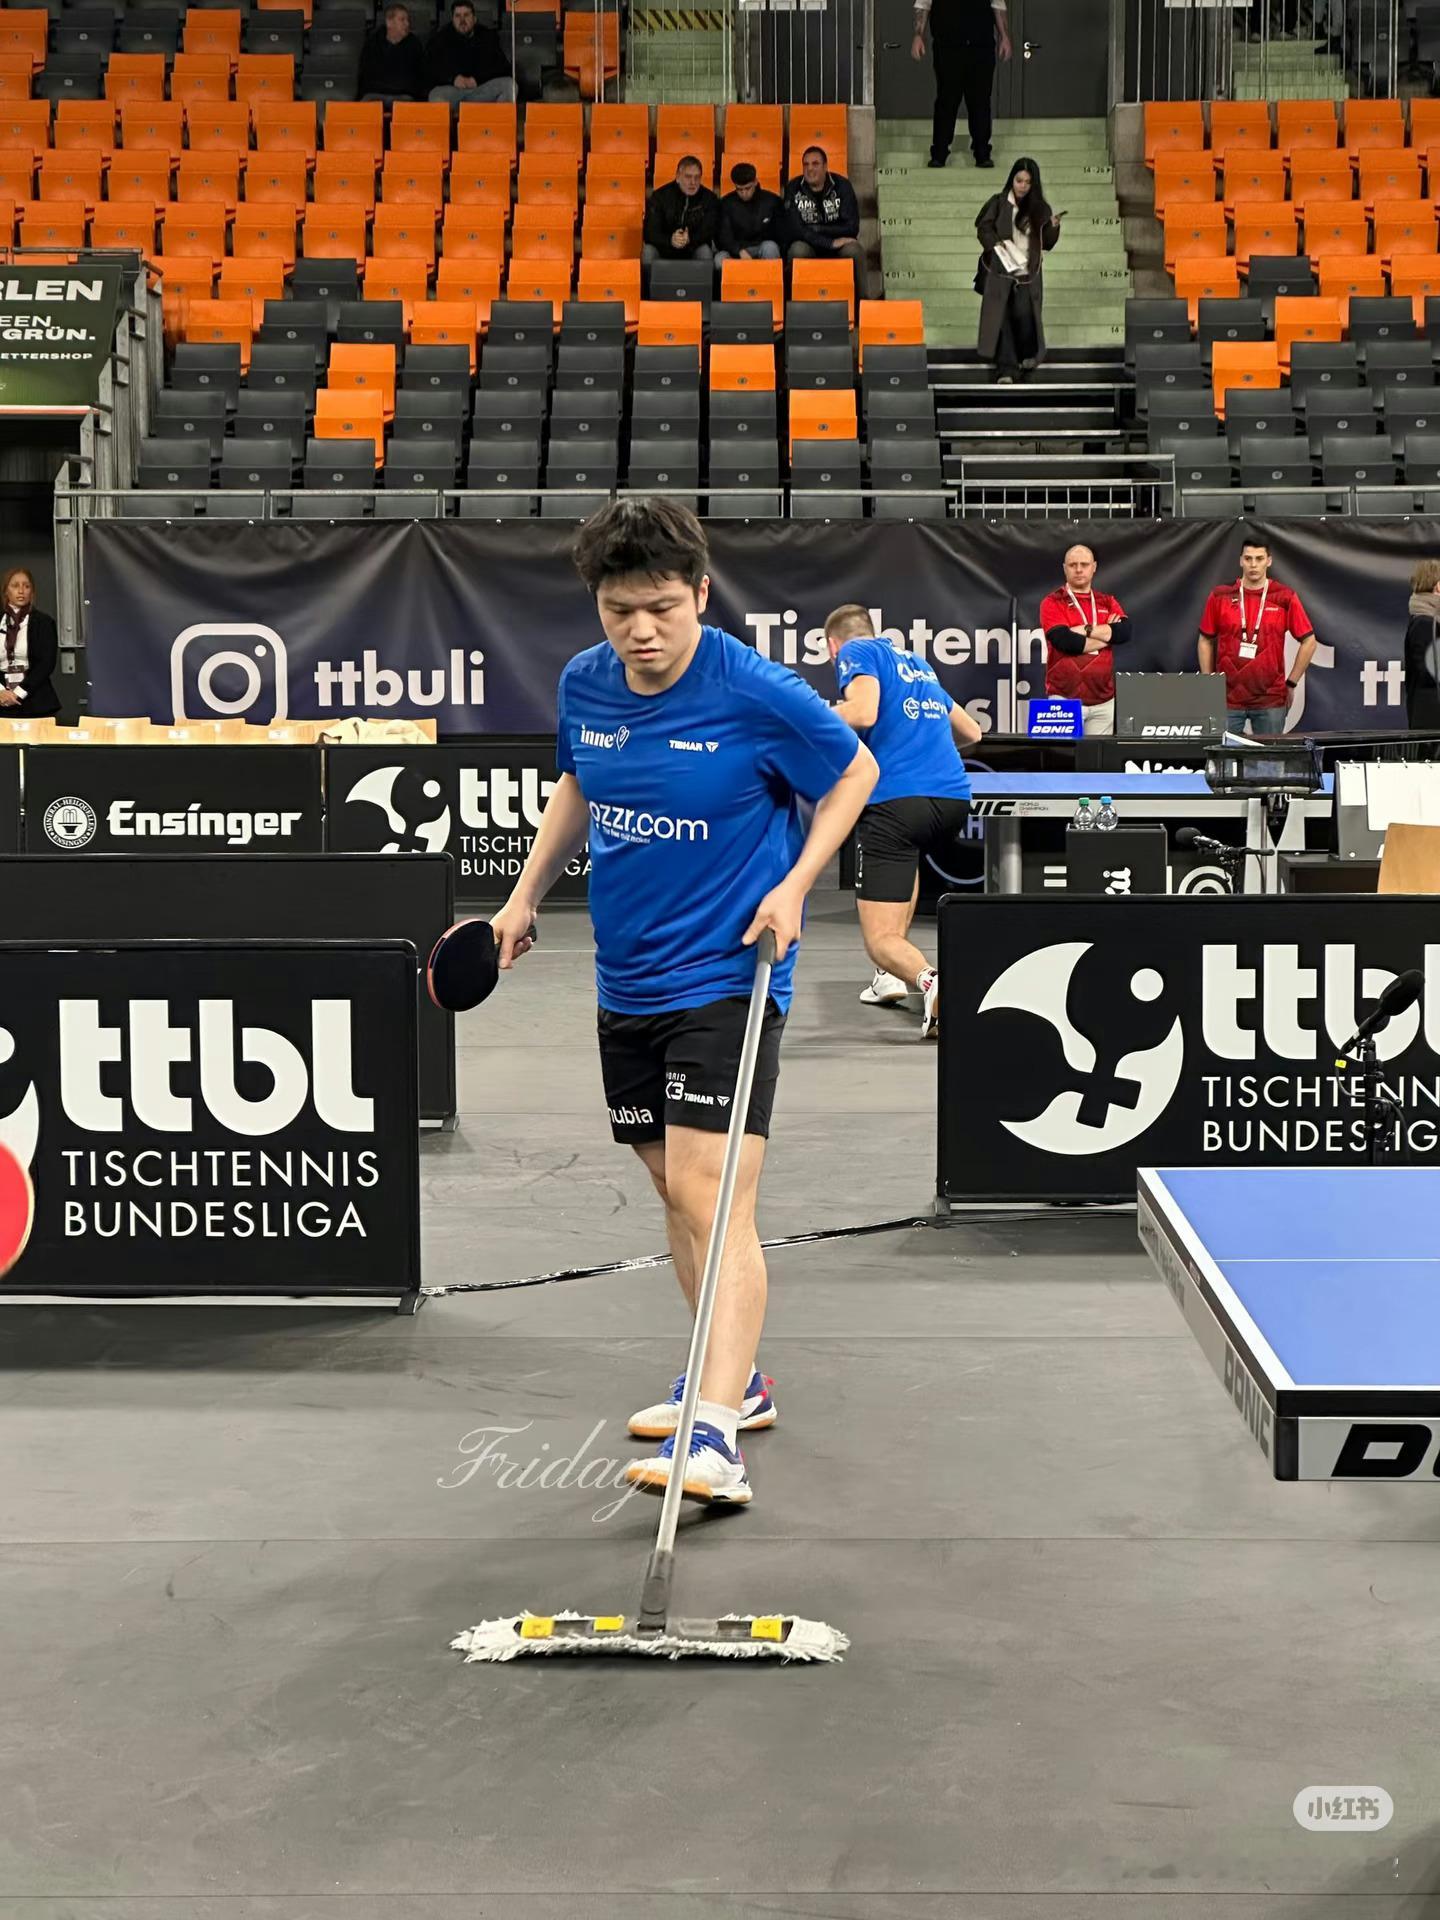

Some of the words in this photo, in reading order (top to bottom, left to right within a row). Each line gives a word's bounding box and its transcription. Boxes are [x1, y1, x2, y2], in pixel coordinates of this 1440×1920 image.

[2, 326, 96, 340] GRÜN.
[314, 649, 484, 706] ttbuli
[1031, 725, 1075, 734] DONIC
[1036, 711, 1074, 719] practice
[1141, 725, 1203, 736] DONIC
[106, 801, 302, 845] Ensinger
[461, 858, 592, 876] BUNDGA
[1202, 944, 1440, 1063] ttb
[58, 999, 375, 1136] ttbl
[1202, 1075, 1440, 1108] TISCHTENN
[1203, 1119, 1440, 1152] BUNDESIG
[61, 1150, 379, 1187] TISCHTENNIS
[64, 1201, 367, 1238] BUNDESLIGA
[1223, 1340, 1271, 1459] DONIC
